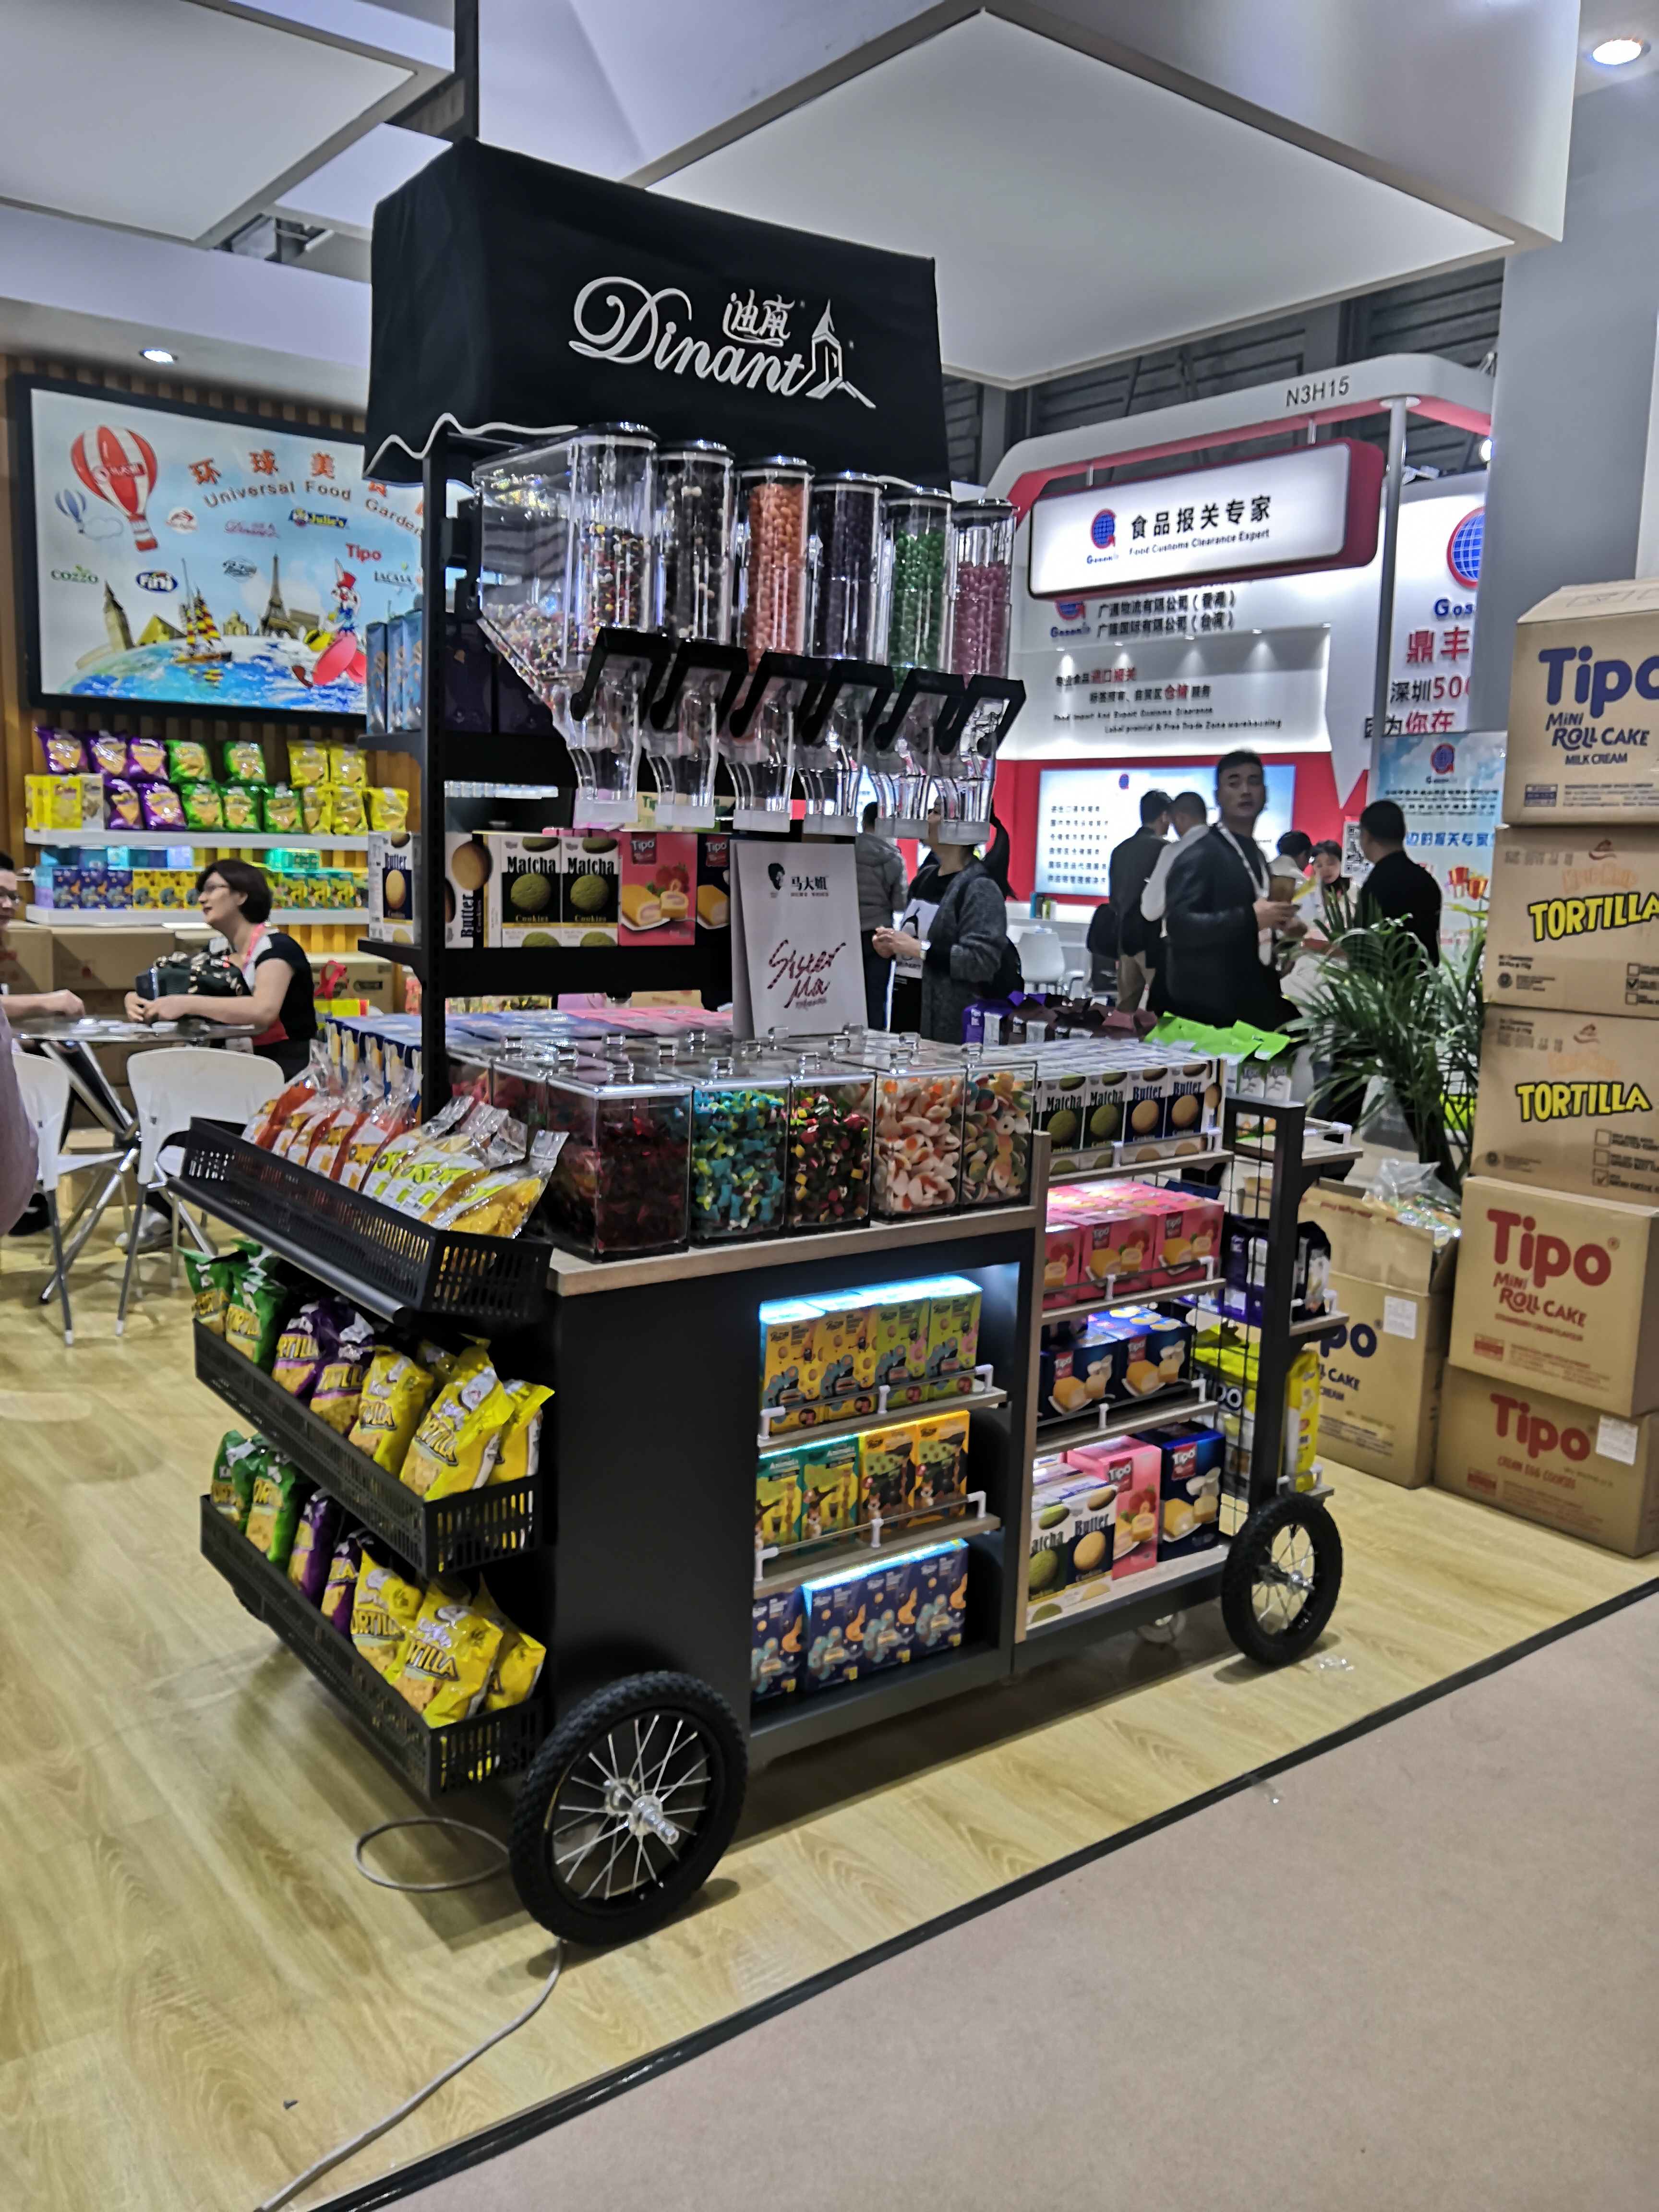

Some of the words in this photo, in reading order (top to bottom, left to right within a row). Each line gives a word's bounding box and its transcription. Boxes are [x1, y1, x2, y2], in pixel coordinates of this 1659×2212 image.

[568, 276, 805, 397] Dinant
[1286, 375, 1350, 407] N3H15
[203, 481, 296, 508] Universal
[304, 480, 351, 501] Food
[1131, 494, 1272, 540] 食品报关专家
[346, 542, 383, 563] Tipo
[1152, 541, 1189, 553] Customs
[1191, 534, 1236, 547] Clearance
[1238, 529, 1270, 542] Expert
[1406, 625, 1470, 663] 鼎丰
[1551, 727, 1598, 751] ROLL
[1601, 726, 1650, 746] CAKE
[1565, 754, 1590, 766] MILK
[1591, 752, 1628, 765] CREAM
[631, 840, 655, 852] Tipo
[706, 841, 727, 853] Tipo
[385, 852, 407, 870] Butter
[507, 856, 556, 874] Matcha
[567, 856, 614, 875] Matcha
[791, 876, 828, 891] 马大姐
[460, 894, 474, 938] Butter
[1527, 891, 1659, 942] TORTILLA
[1090, 1088, 1124, 1106] Matcha
[1132, 1085, 1163, 1101] Butter
[1173, 1081, 1202, 1096] Butter
[1046, 1094, 1082, 1112] Matcha
[1515, 1081, 1653, 1122] TORTILLA
[1486, 1209, 1612, 1288] Tipo
[1499, 1286, 1539, 1315] ROLL
[1543, 1300, 1587, 1328] CAKE
[1320, 1323, 1377, 1358] po
[1328, 1368, 1360, 1391] CAKE
[1490, 1393, 1591, 1461] Tipo
[1171, 1447, 1196, 1466] Tipo
[1107, 1463, 1132, 1482] Tipo
[1074, 1513, 1110, 1537] Butter
[1031, 1530, 1064, 1554] atcha
